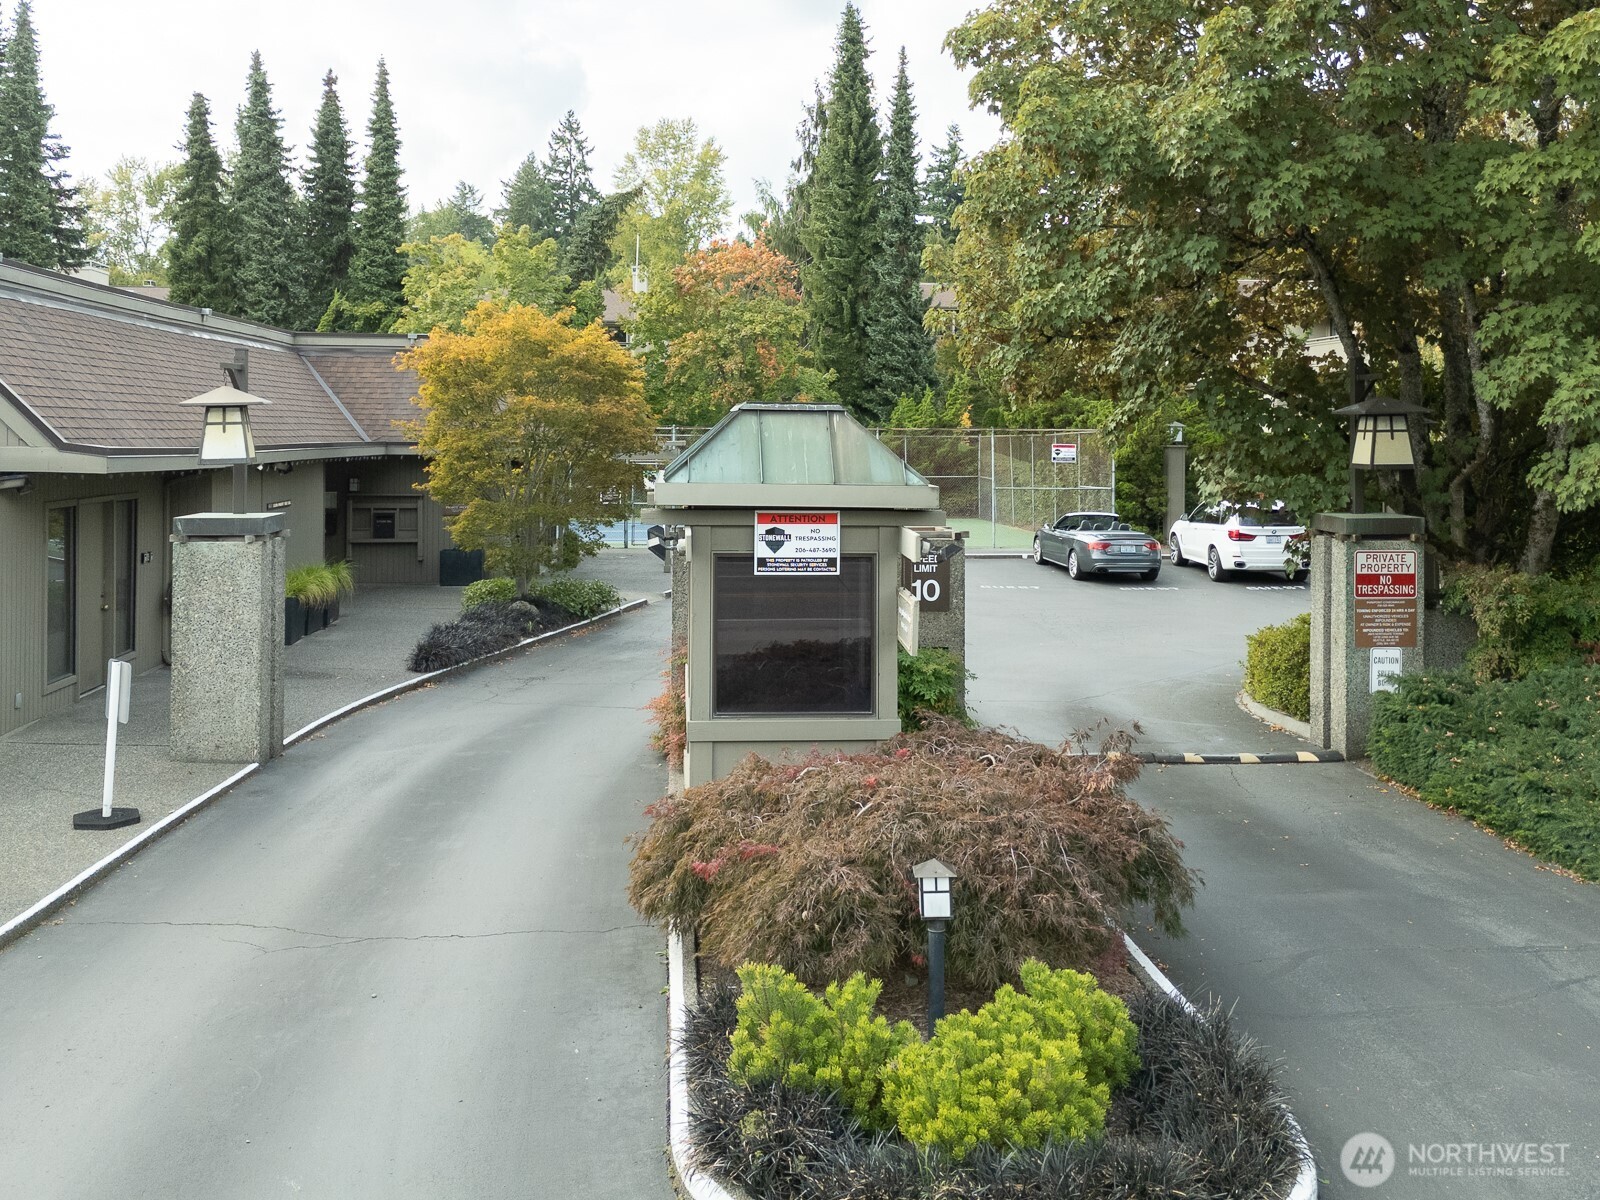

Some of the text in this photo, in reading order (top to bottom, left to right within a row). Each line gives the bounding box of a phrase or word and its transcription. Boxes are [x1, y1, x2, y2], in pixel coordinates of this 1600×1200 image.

[770, 515, 826, 523] ATTENTION
[1366, 554, 1406, 562] PRIVATE
[914, 564, 938, 572] LIMIT
[1360, 564, 1412, 572] PROPERTY
[1380, 576, 1392, 584] NO
[912, 580, 940, 602] 10
[1358, 585, 1414, 594] TRESPASSING
